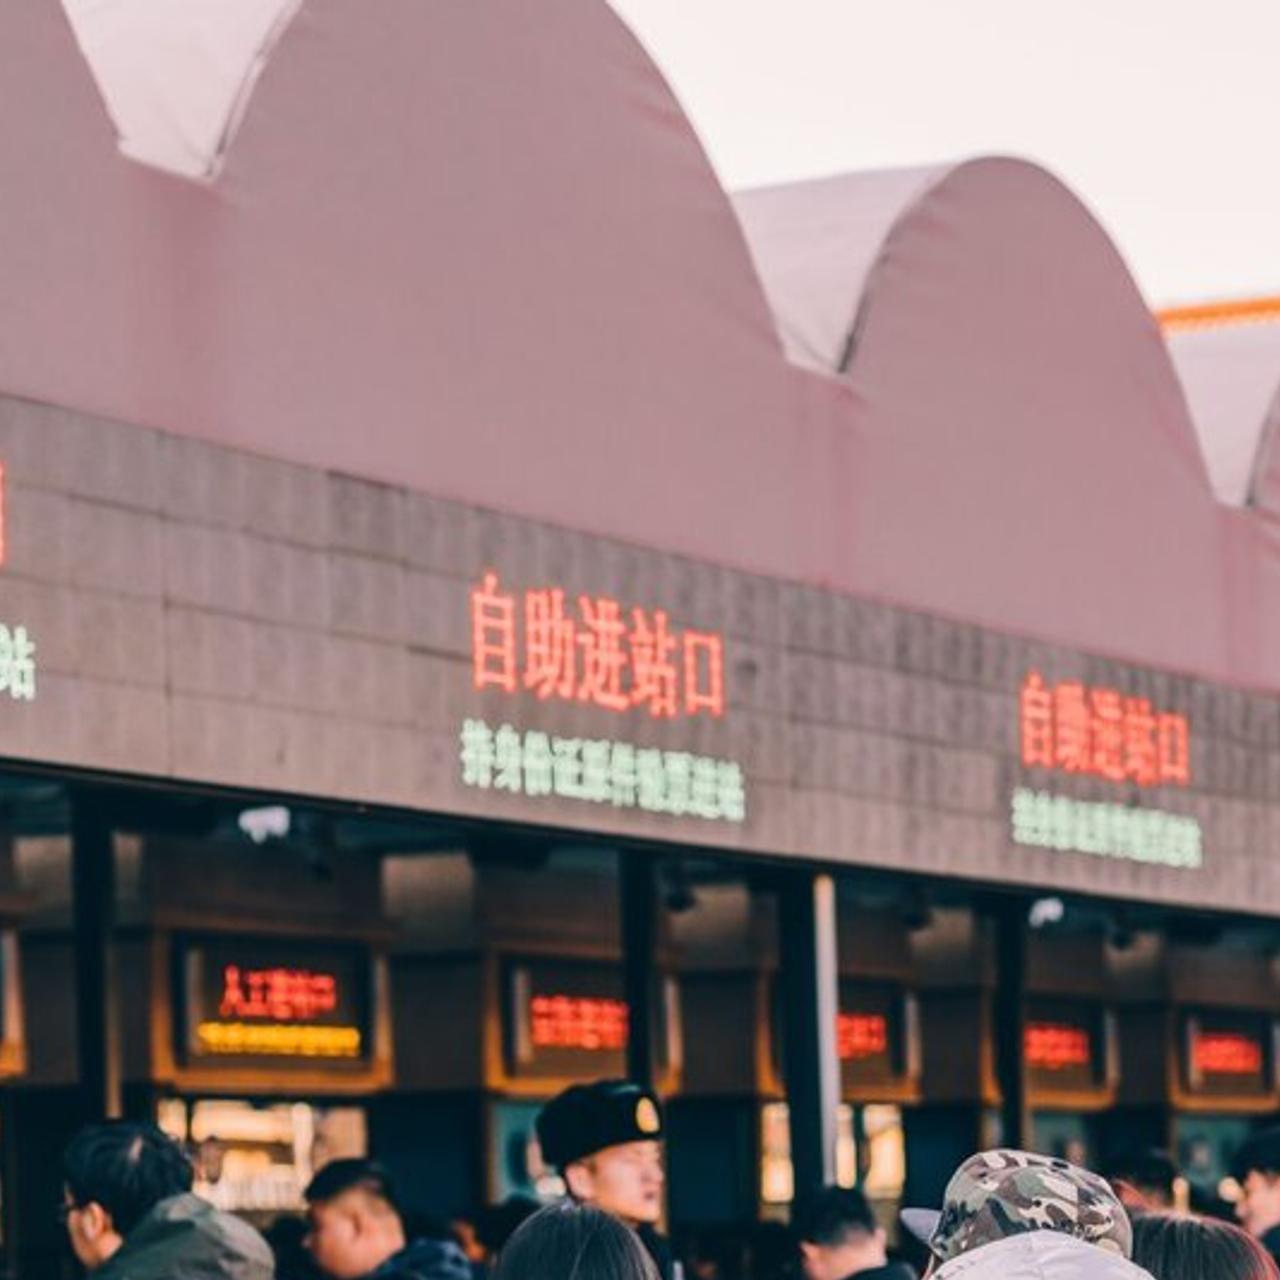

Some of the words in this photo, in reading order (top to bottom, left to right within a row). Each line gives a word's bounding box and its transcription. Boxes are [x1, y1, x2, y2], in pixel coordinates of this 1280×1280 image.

[470, 571, 726, 720] 自助进站口
